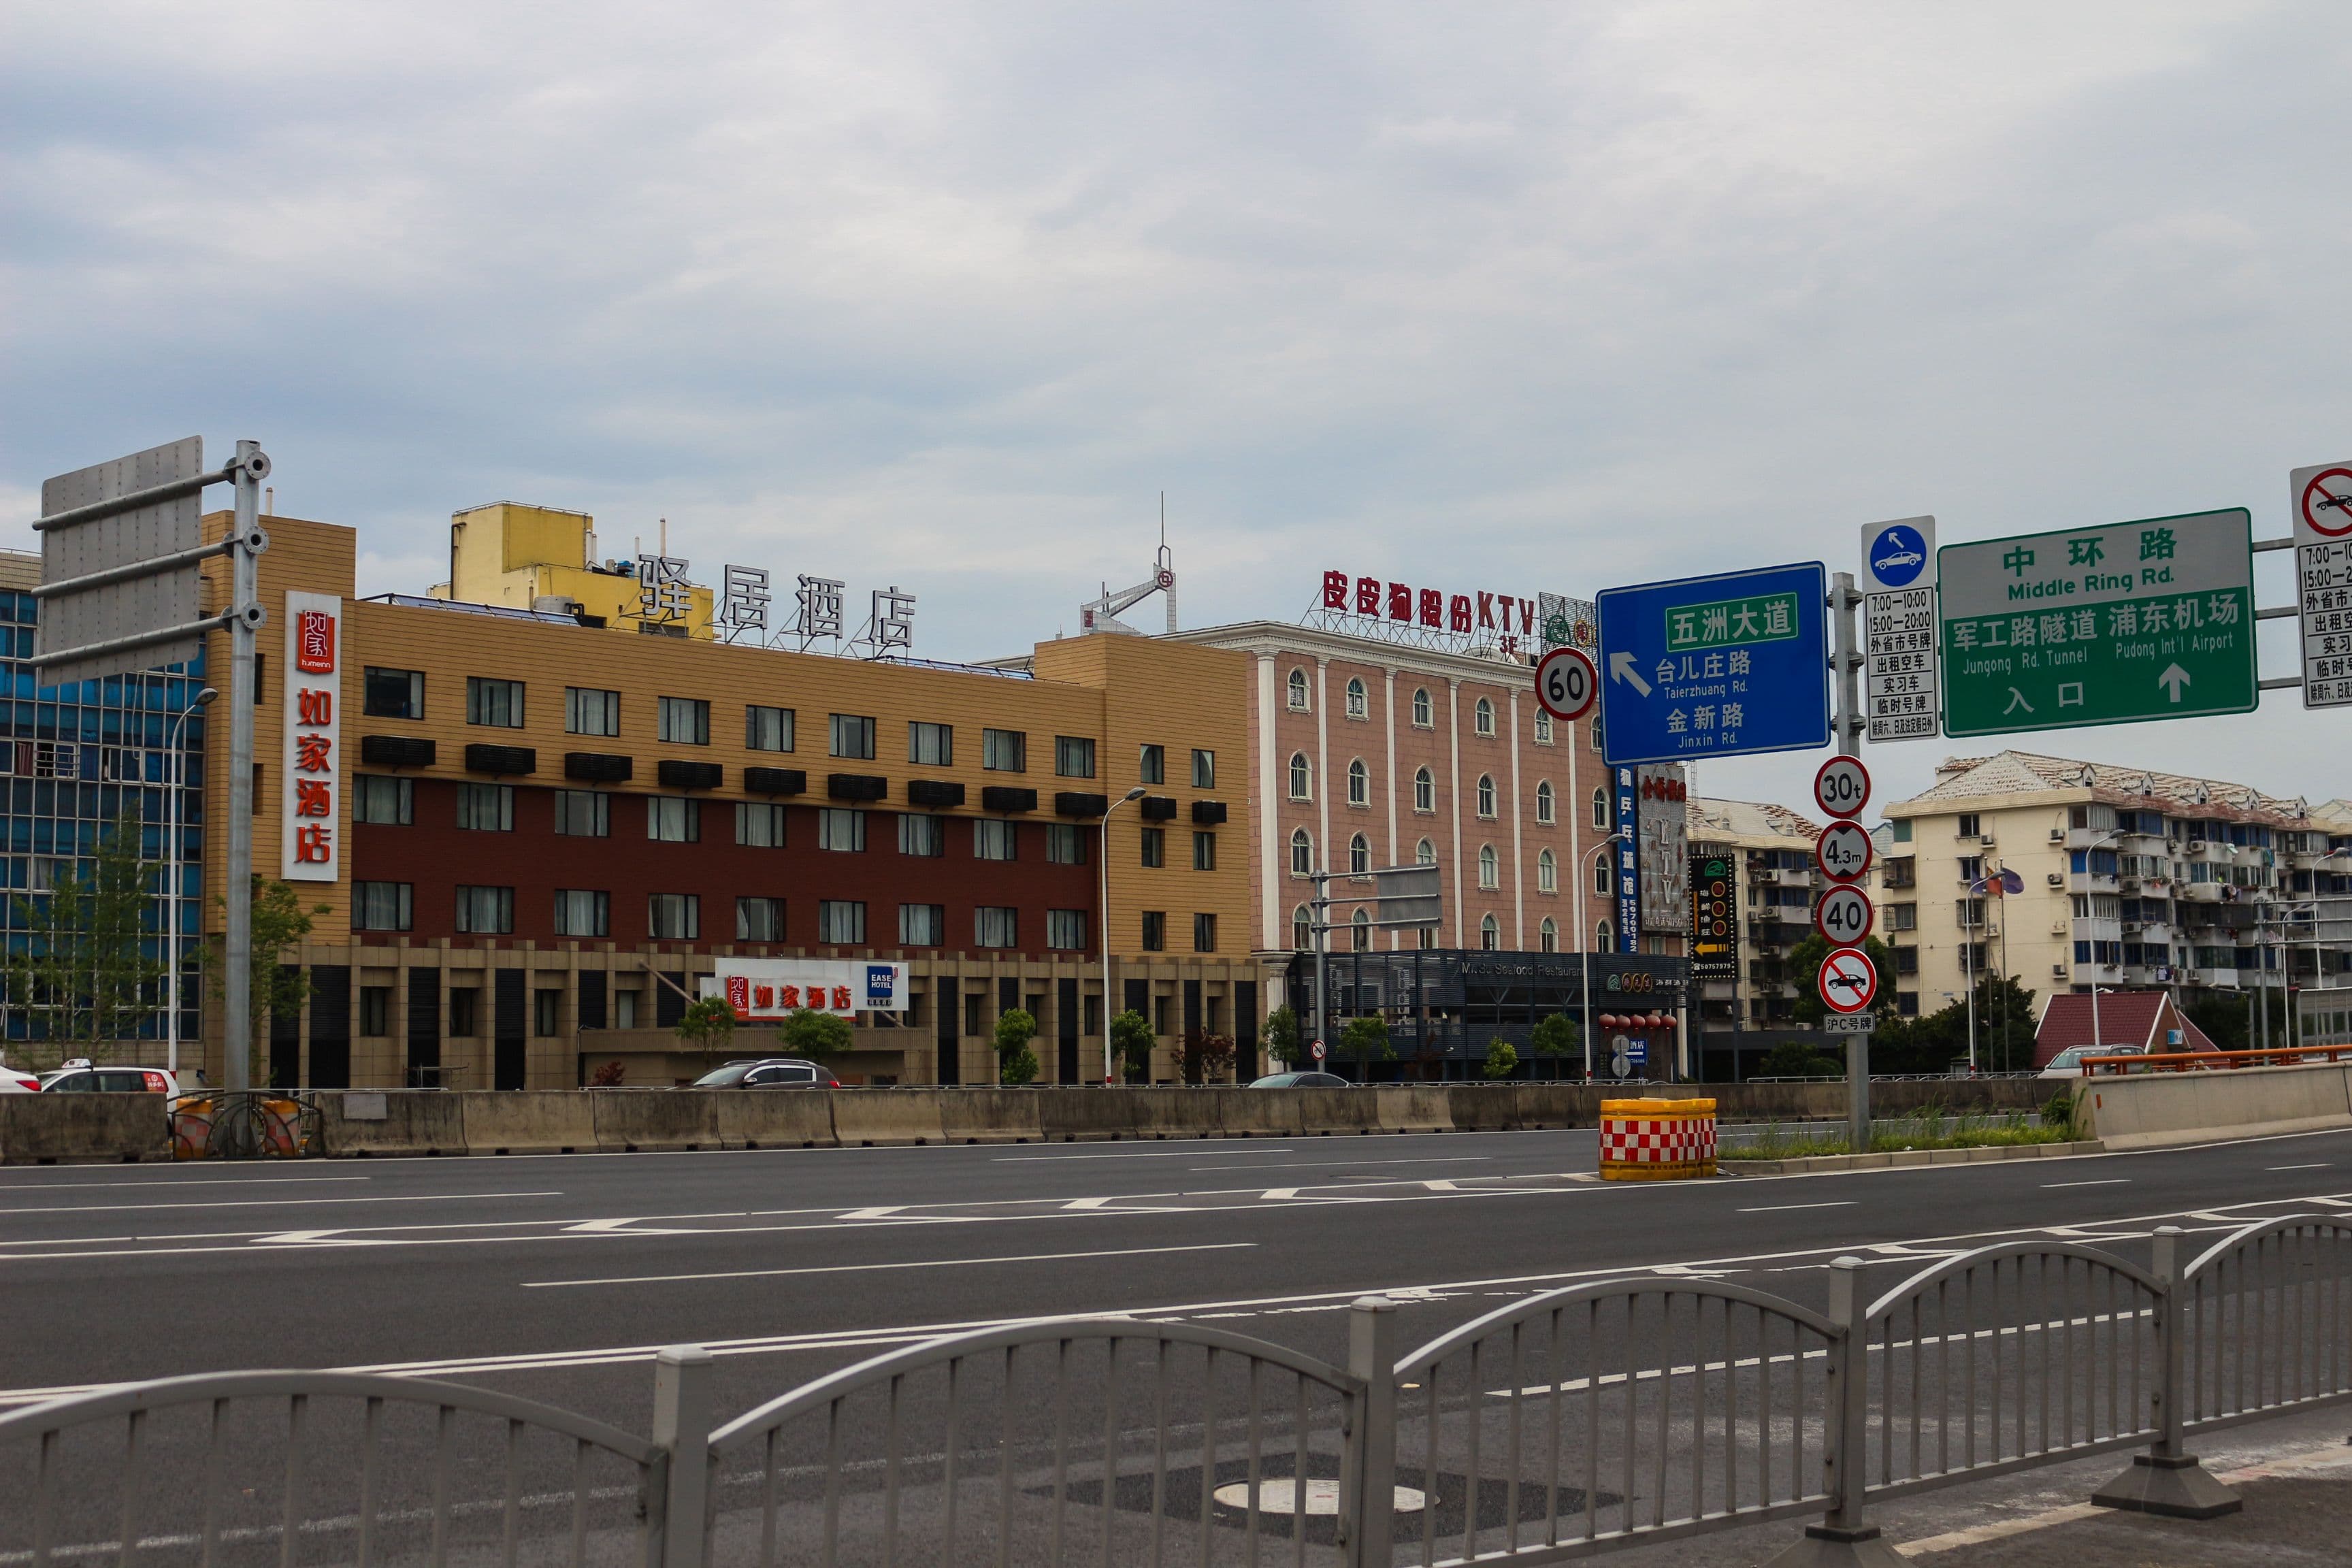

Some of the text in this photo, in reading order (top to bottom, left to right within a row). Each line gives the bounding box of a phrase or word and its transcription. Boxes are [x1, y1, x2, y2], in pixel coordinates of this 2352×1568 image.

[2004, 527, 2176, 577] 中环路
[2008, 566, 2174, 600] Middle Ring Rd.
[638, 554, 916, 647] 驿居酒店
[2306, 589, 2352, 610] 外省市
[1671, 600, 1792, 644] 五洲大道
[2108, 593, 2238, 637] 浦东机场
[1871, 632, 1931, 653] 外省市号牌
[1953, 609, 2097, 651] 军工路隧道
[1499, 636, 1518, 654] 3F
[2116, 641, 2155, 661] Pudong
[2192, 632, 2233, 651] Airport
[1656, 649, 1752, 684] 台儿庄路
[1878, 653, 1925, 672] 出租空车
[1963, 647, 2087, 677] Jungong Rd. Tunnel
[1548, 666, 1584, 702] 60
[1665, 681, 1748, 700] Taierzhuang Rd.
[1884, 675, 1919, 693] 实习车
[2003, 682, 2084, 715] 入口
[1667, 702, 1744, 734] 金新路
[1878, 695, 1926, 715] 临时号牌
[1678, 732, 1737, 749] Jinxin Rd.
[293, 687, 332, 863] 如家酒店
[1823, 772, 1861, 802] 30t
[1825, 839, 1861, 864] 4.3m
[1827, 902, 1861, 931] 40
[871, 974, 892, 982] EASE
[1538, 965, 1584, 977] Restauran
[753, 985, 851, 1010] 如家酒店
[1827, 1017, 1872, 1032] 沪C号牌
